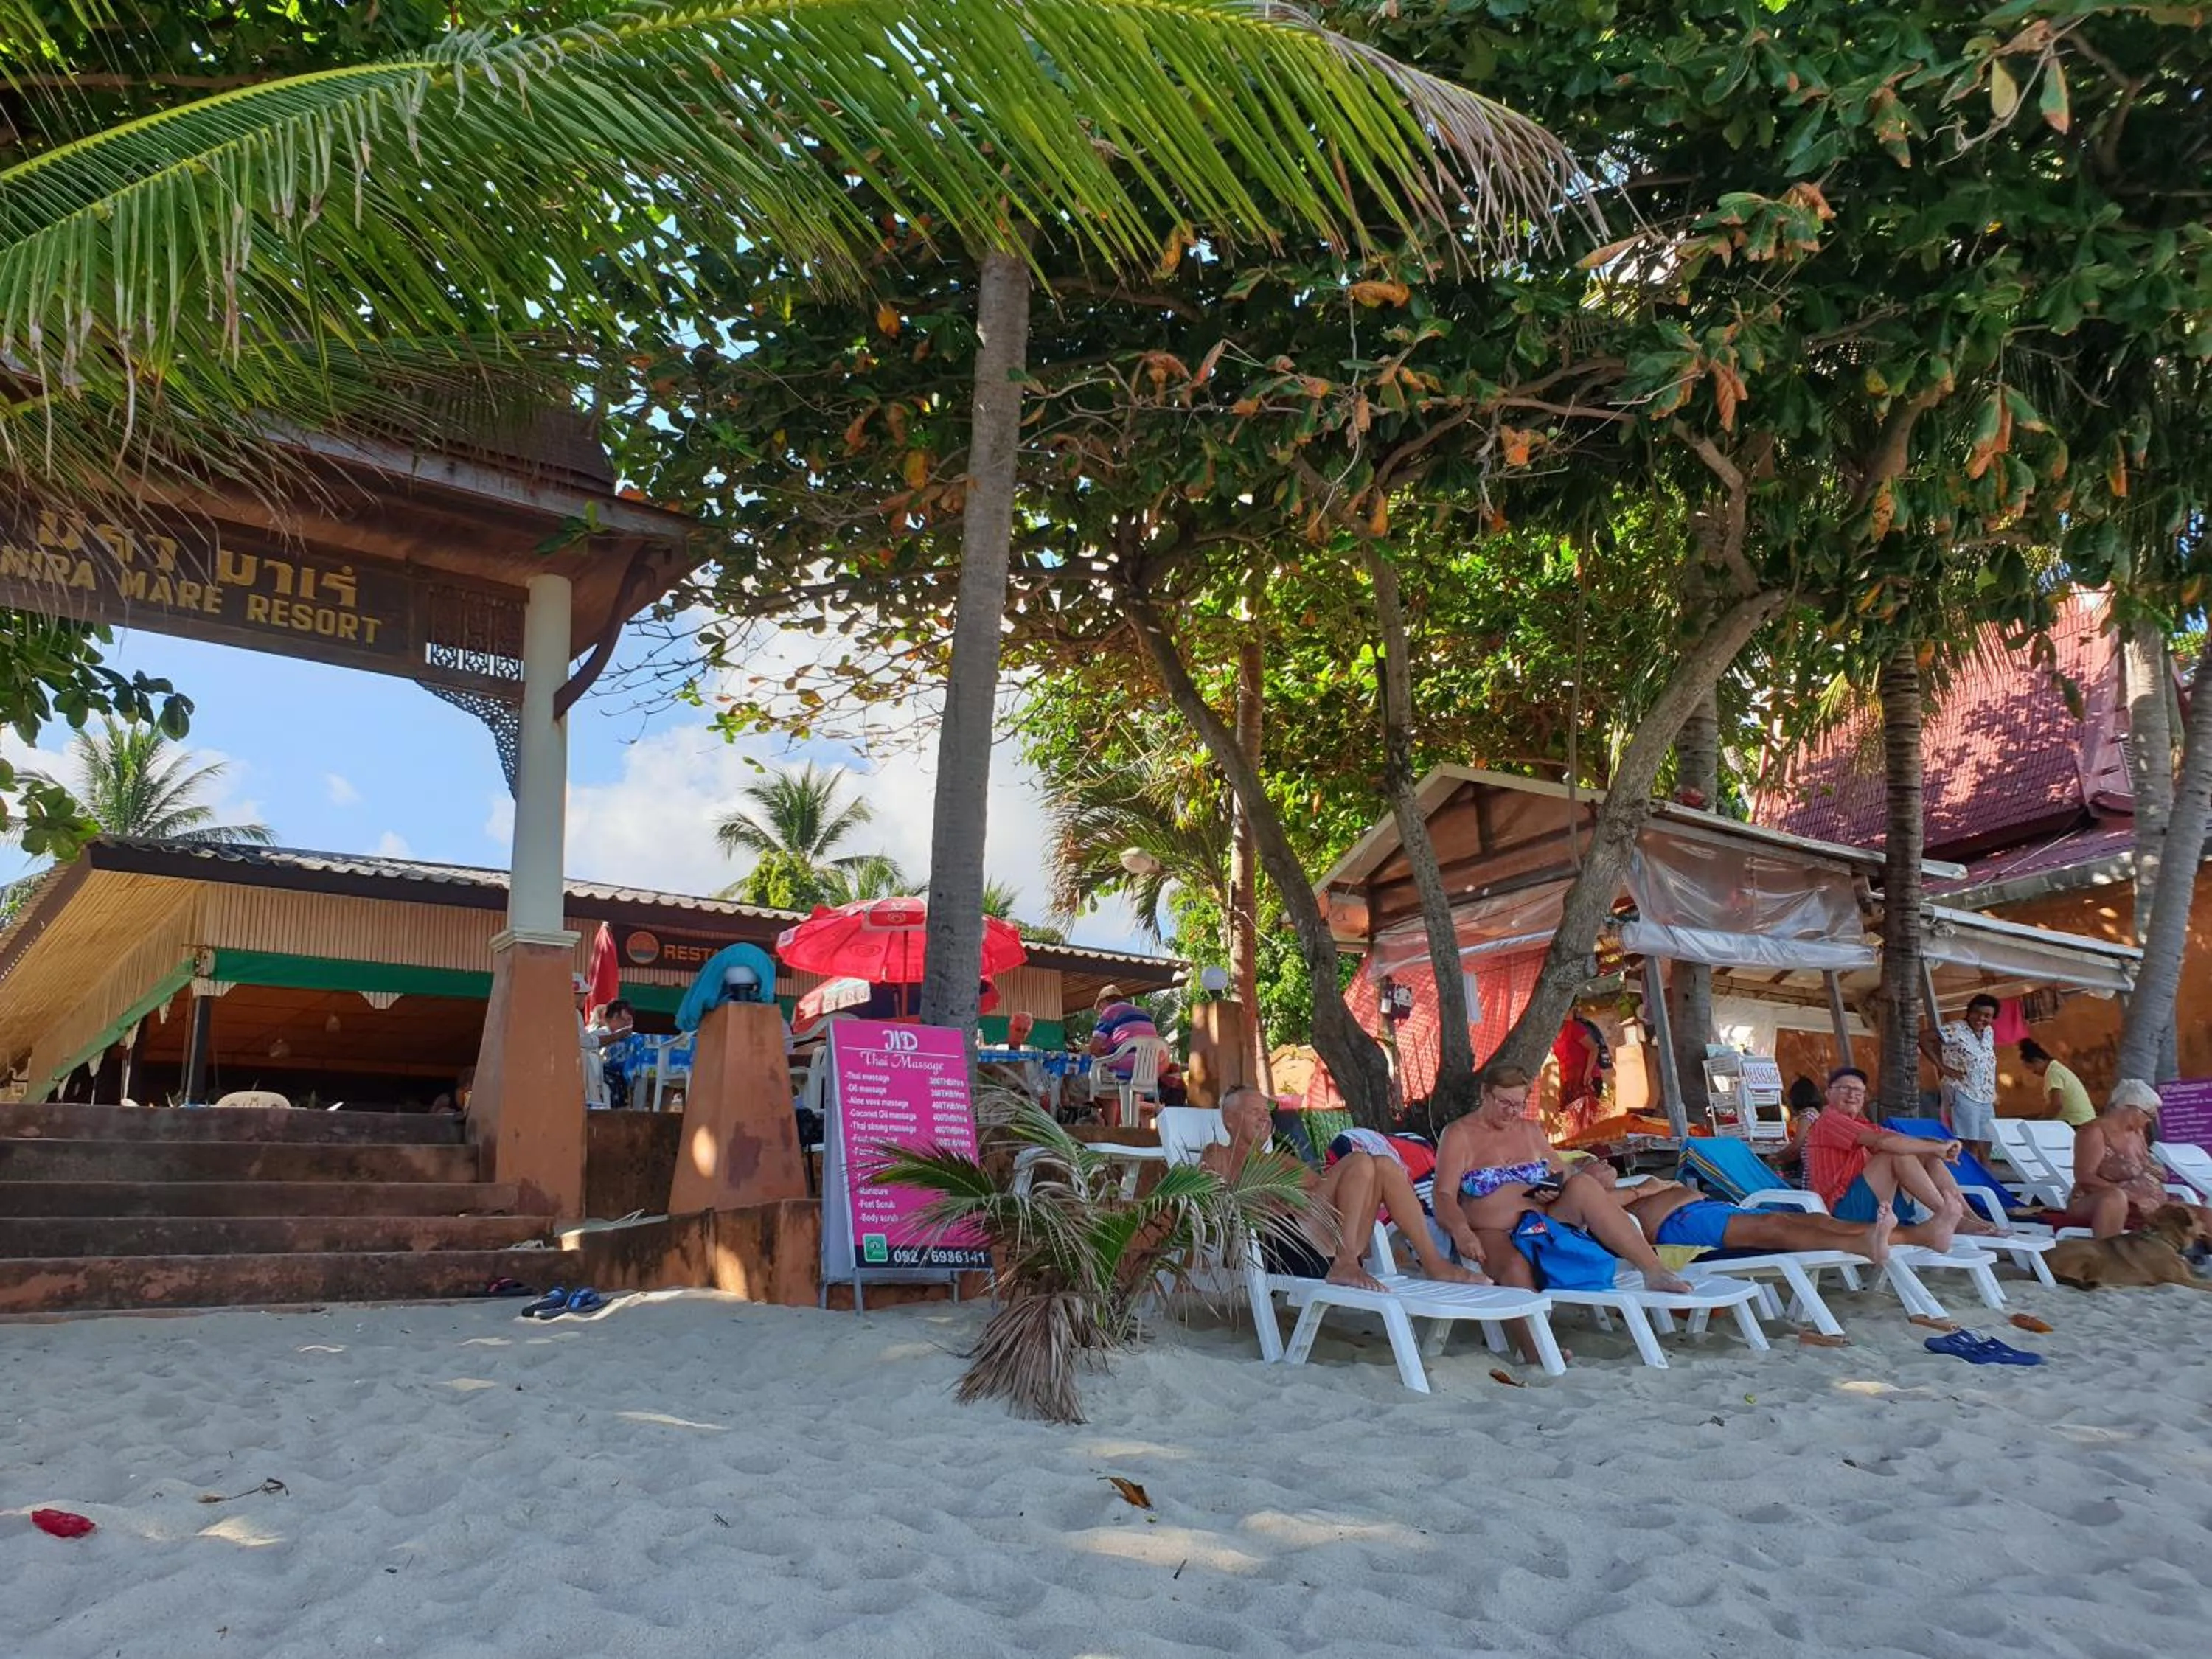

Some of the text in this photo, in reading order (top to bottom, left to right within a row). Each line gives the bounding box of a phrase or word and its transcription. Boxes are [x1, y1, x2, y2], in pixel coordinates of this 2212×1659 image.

[118, 571, 223, 613] MARE
[247, 594, 382, 644] RESORT
[860, 1051, 945, 1076] Thai Massage
